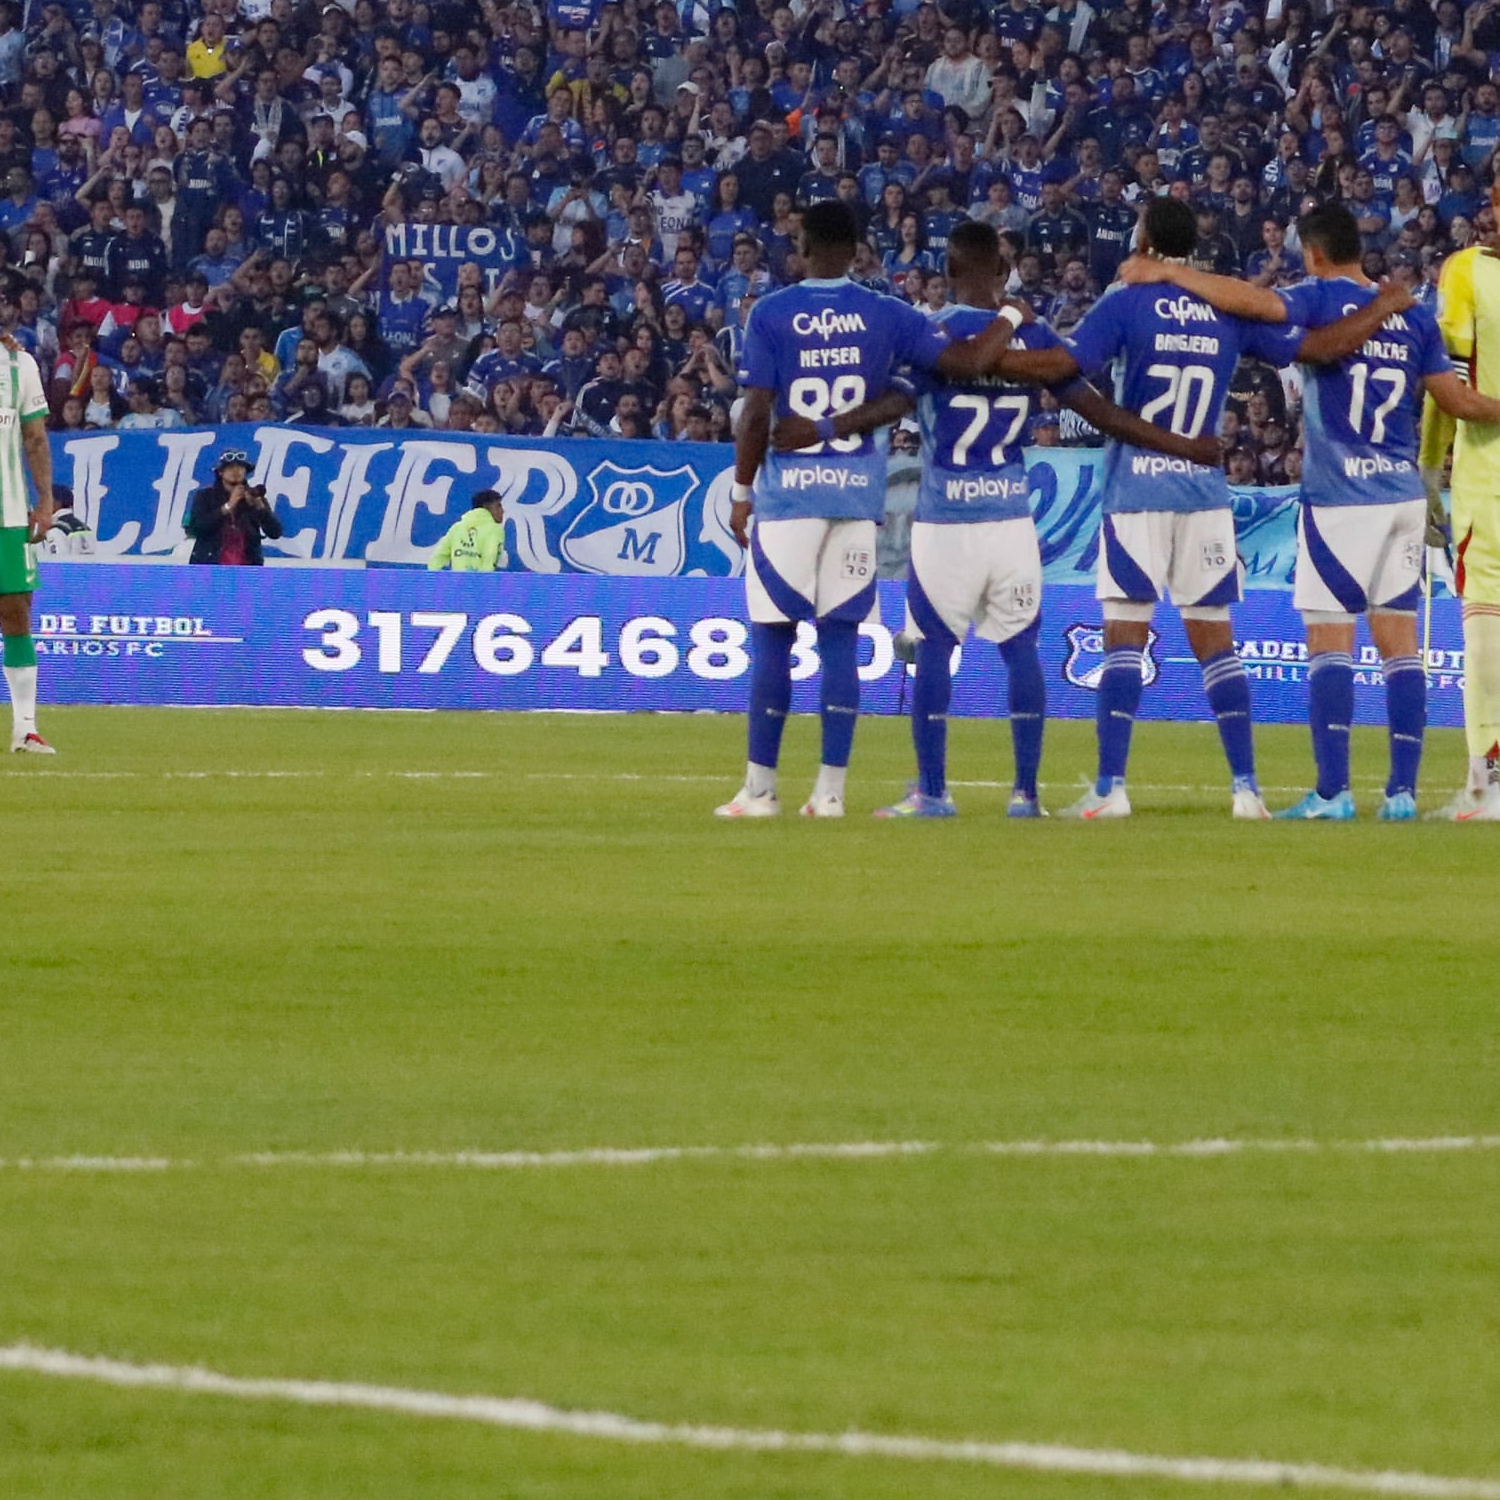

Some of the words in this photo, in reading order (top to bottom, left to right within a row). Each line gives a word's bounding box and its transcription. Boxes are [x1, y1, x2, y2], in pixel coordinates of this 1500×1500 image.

[386, 222, 516, 261] MILLOS
[799, 345, 861, 368] NEYSER
[1139, 363, 1215, 439] 20
[1348, 362, 1407, 444] 17
[948, 394, 1030, 466] 77
[781, 466, 869, 490] Wplay.co
[616, 527, 663, 565] M
[39, 614, 77, 635] DE
[89, 614, 212, 637] FUTBOL
[126, 641, 164, 658] FC
